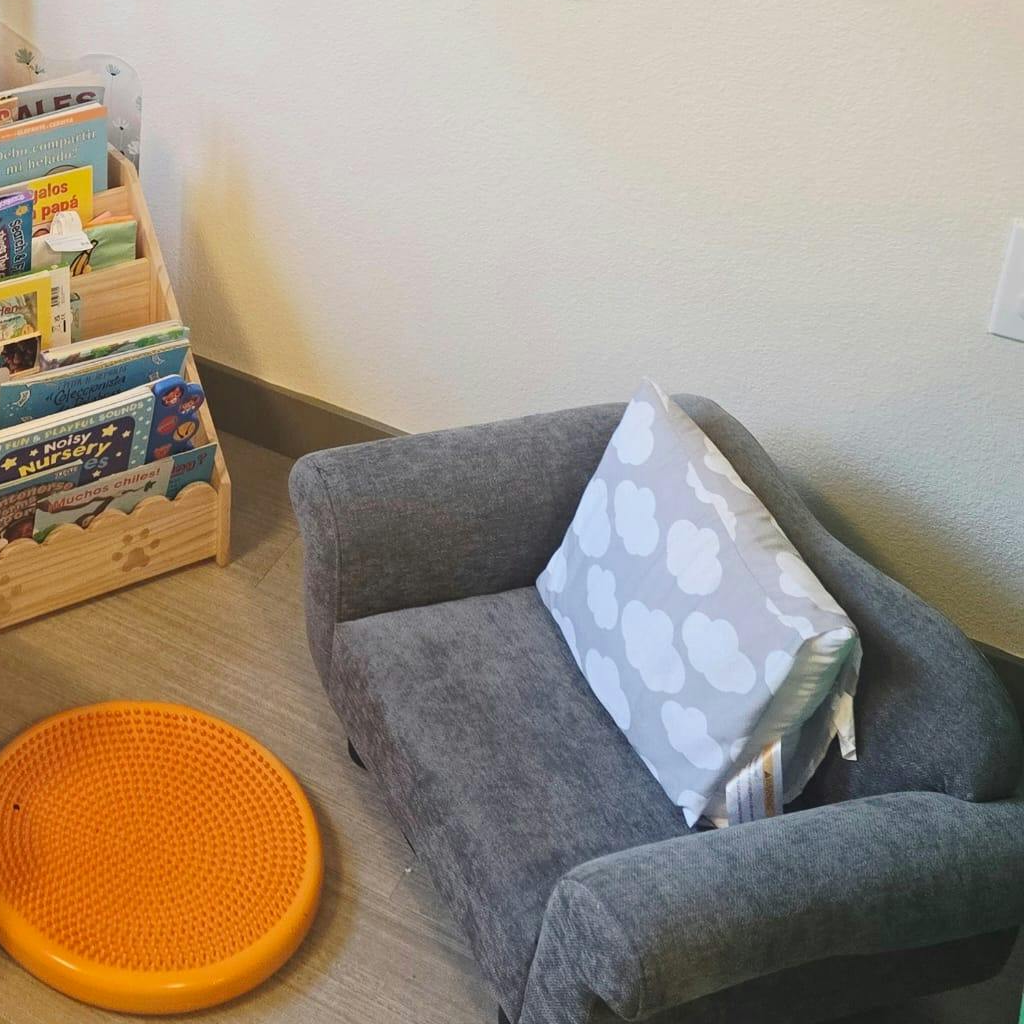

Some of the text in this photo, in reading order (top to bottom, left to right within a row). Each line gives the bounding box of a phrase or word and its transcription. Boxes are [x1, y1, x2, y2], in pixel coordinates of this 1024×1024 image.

[8, 218, 25, 253] Search
[4, 438, 30, 451] FUN
[32, 434, 41, 444] &
[44, 418, 96, 439] PLAYFUL
[98, 401, 144, 422] SOUNDS
[43, 431, 92, 456] Noisy
[17, 441, 113, 478] Nursery
[113, 468, 161, 489] chiles!
